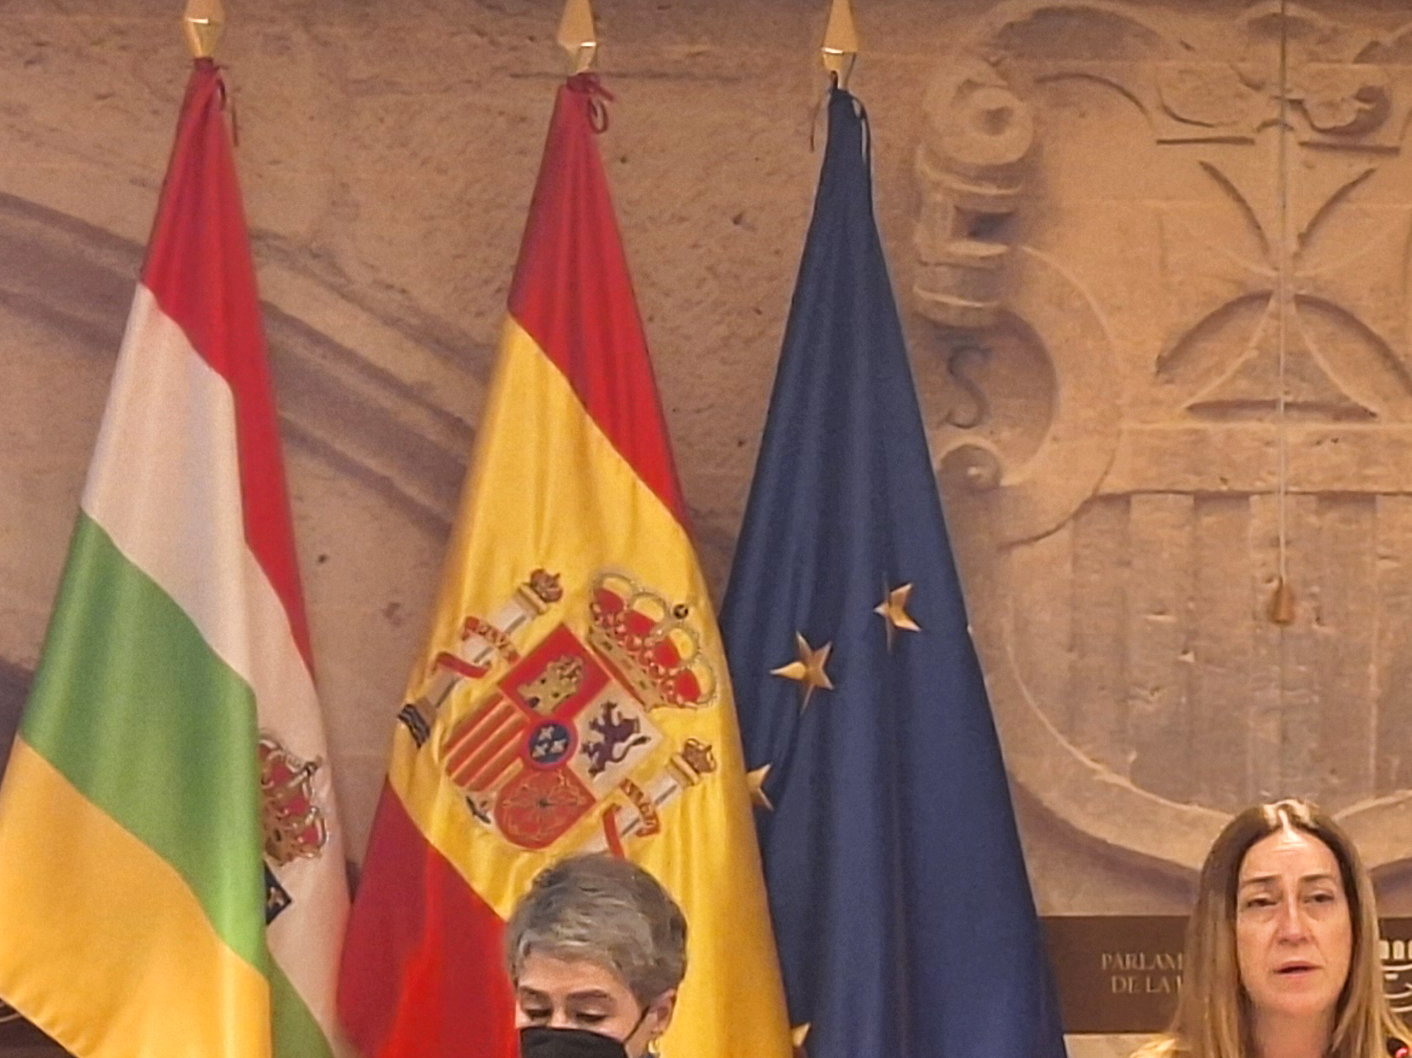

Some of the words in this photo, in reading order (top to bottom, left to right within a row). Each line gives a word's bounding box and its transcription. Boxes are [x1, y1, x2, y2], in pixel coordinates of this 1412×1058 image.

[1102, 952, 1183, 970] PARLAM
[1112, 975, 1141, 994] DE
[1146, 975, 1171, 994] LA
